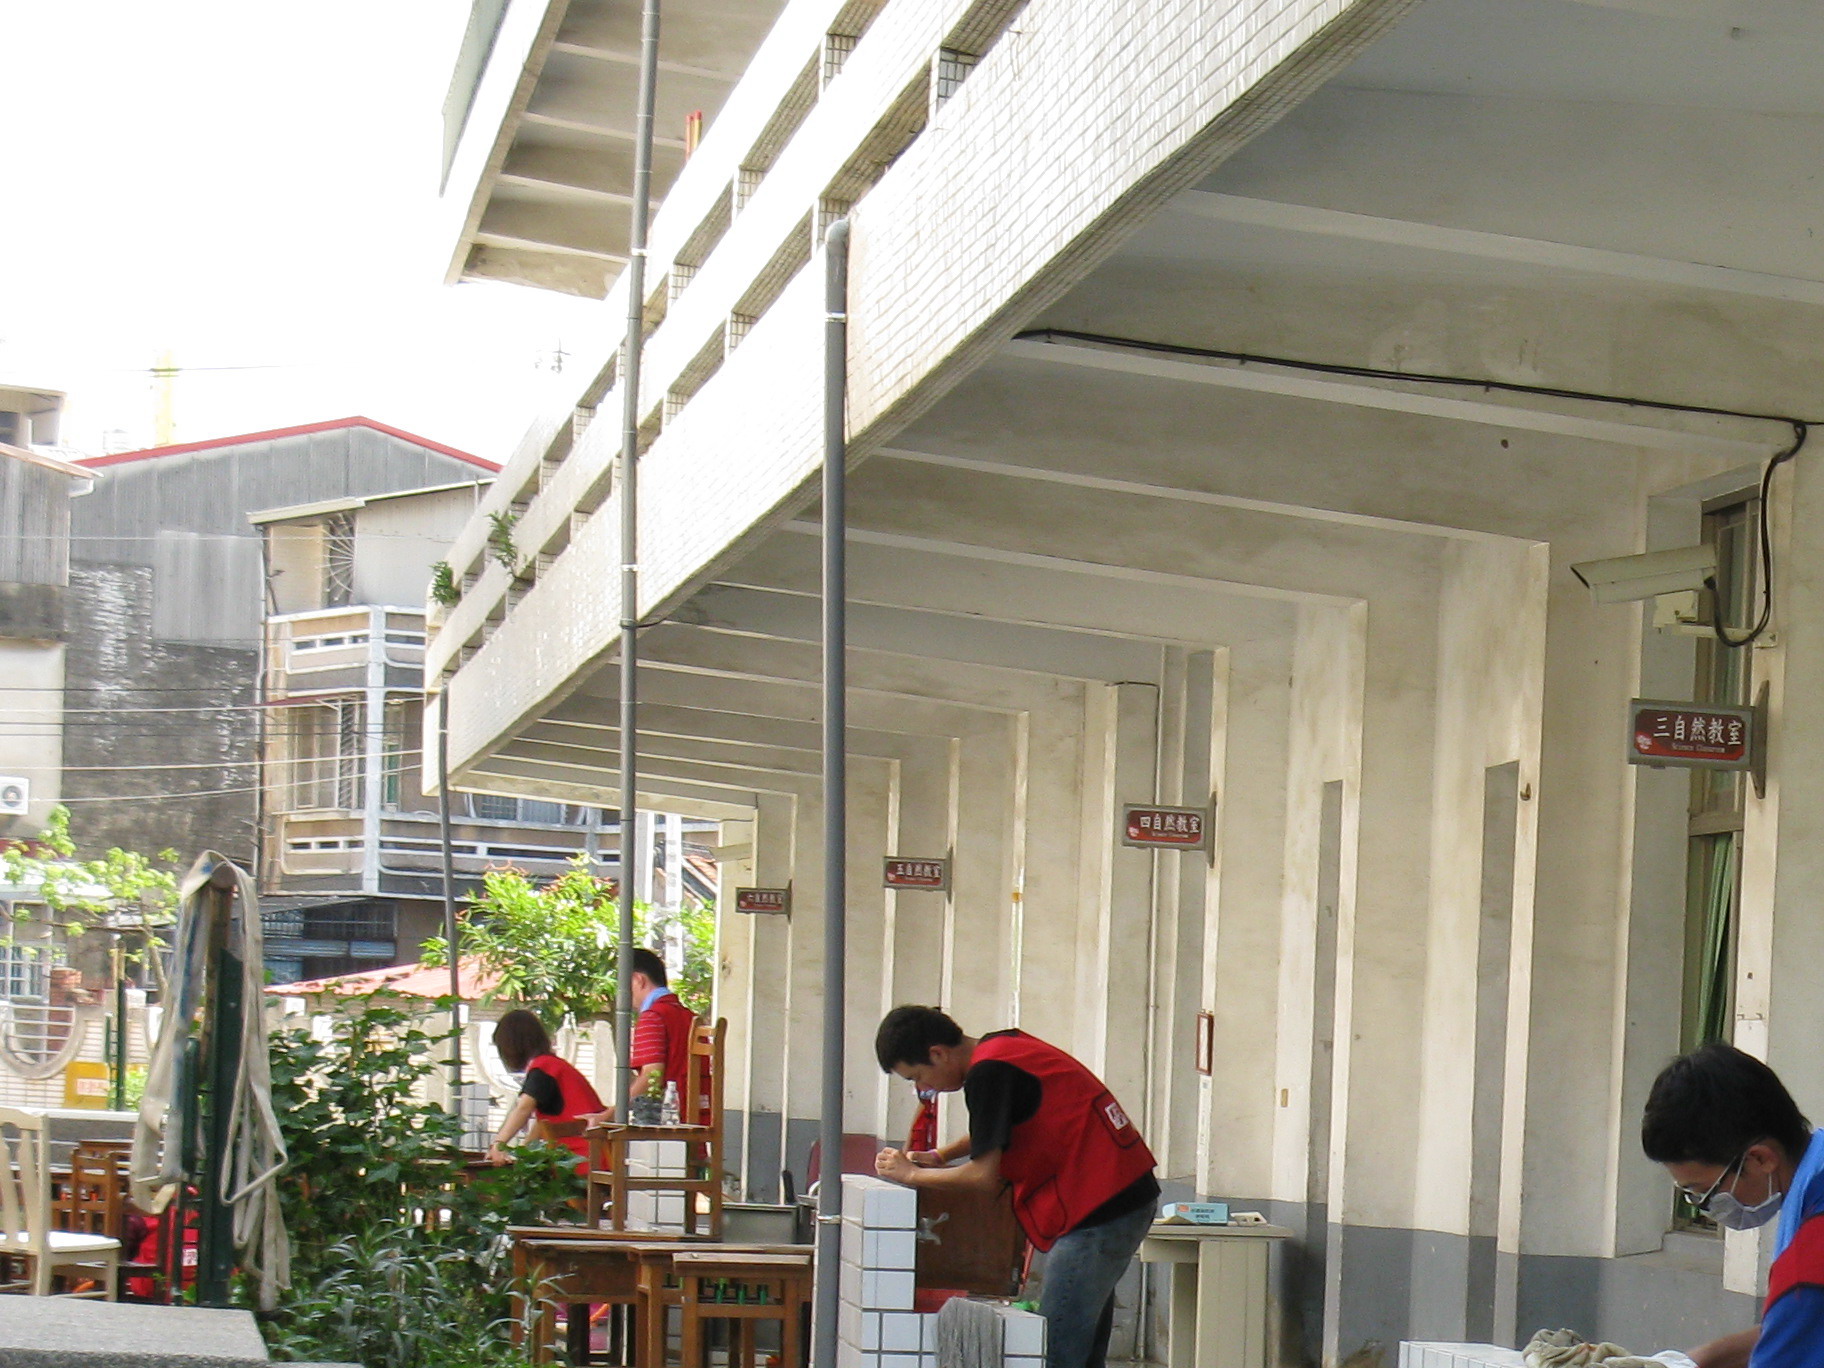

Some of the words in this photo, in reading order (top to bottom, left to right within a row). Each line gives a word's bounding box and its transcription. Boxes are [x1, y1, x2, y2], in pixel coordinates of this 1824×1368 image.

[1652, 714, 1743, 746] 三自然教室
[1139, 813, 1200, 833] 四自然教室
